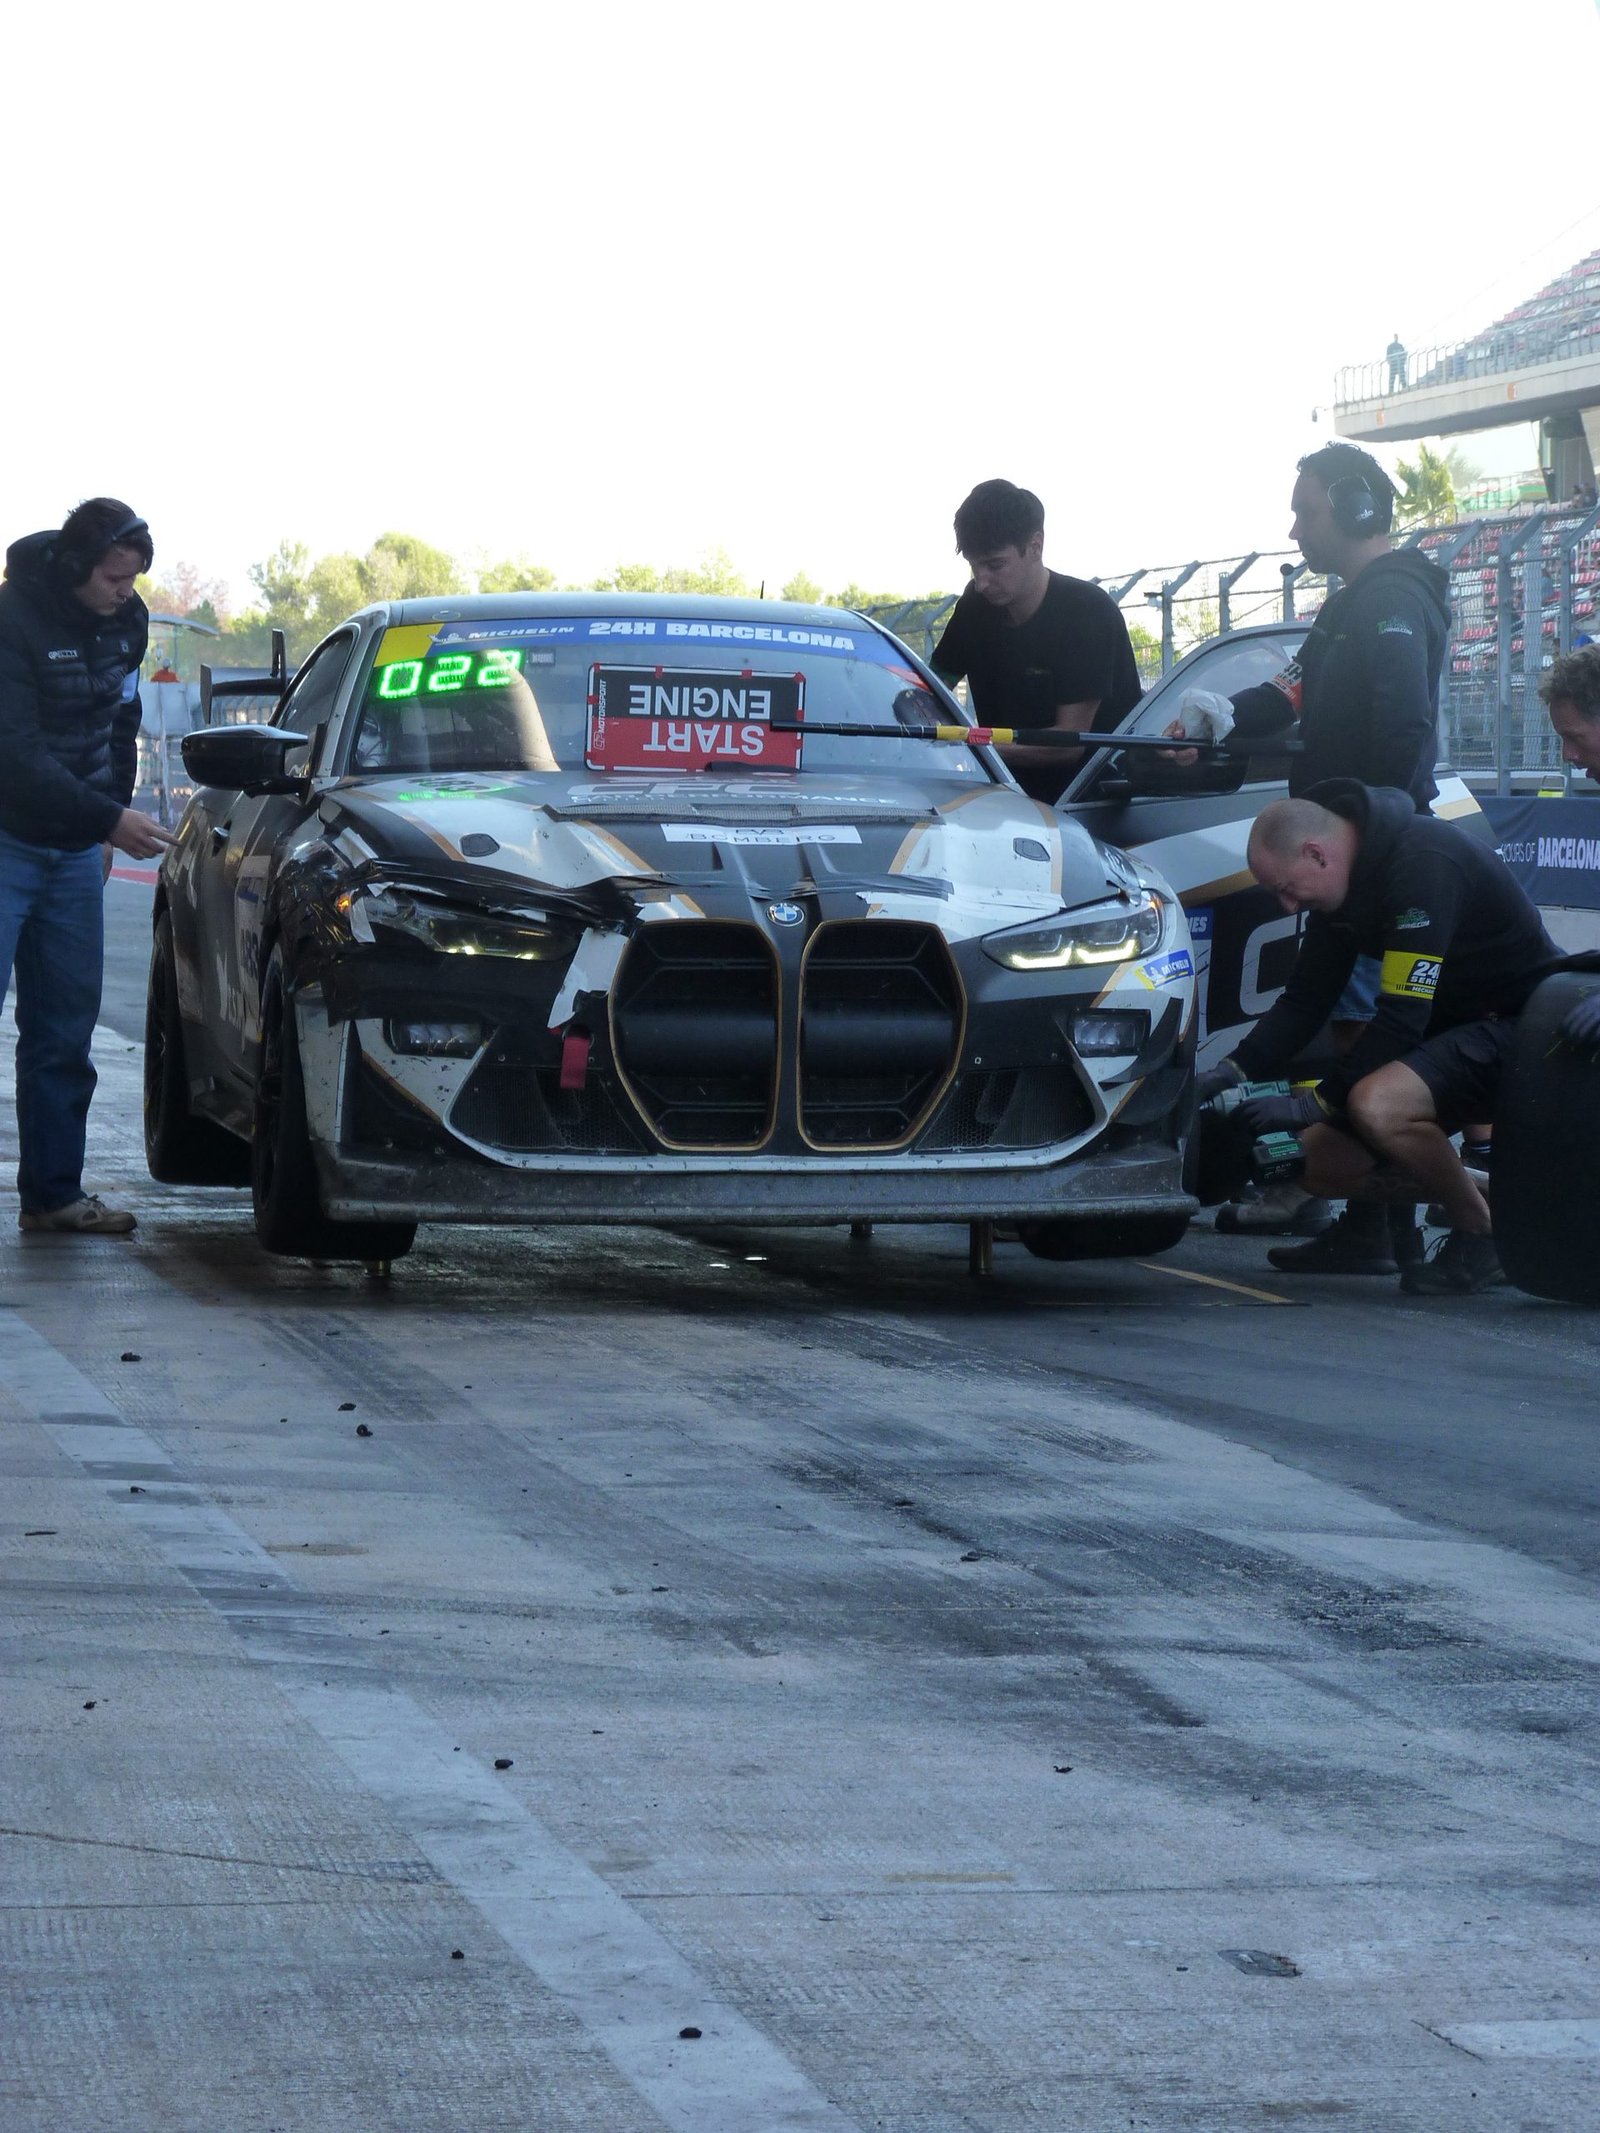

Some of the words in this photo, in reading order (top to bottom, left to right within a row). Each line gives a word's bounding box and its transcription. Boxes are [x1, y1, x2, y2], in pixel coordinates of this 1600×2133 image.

[468, 626, 575, 640] MICHELIN
[588, 621, 656, 636] 24H
[666, 623, 855, 650] BARCELONA
[379, 649, 522, 699] 022
[628, 684, 771, 720] ENGINE
[642, 721, 765, 756] START
[1537, 837, 1600, 870] BARCELONA
